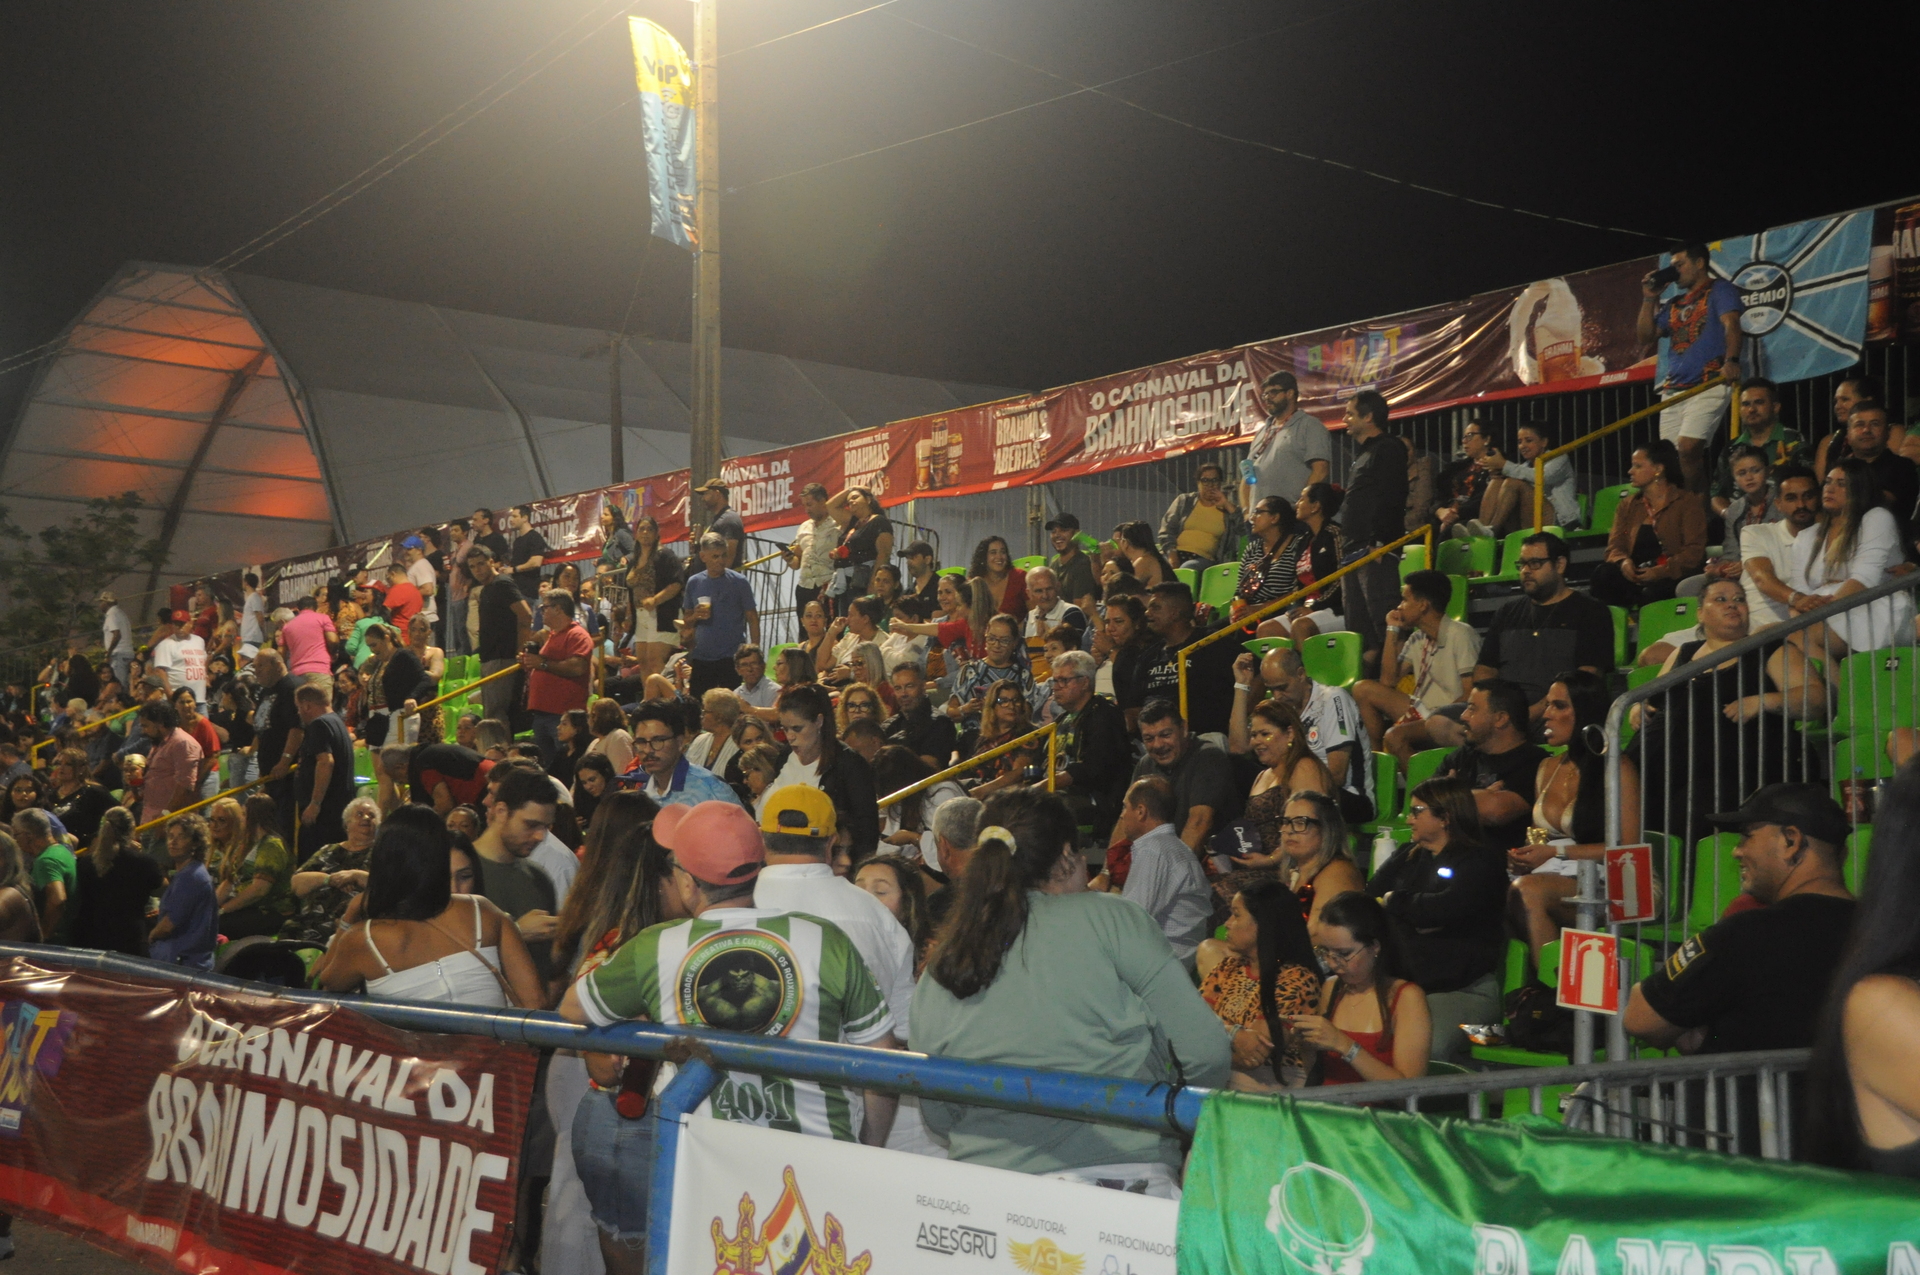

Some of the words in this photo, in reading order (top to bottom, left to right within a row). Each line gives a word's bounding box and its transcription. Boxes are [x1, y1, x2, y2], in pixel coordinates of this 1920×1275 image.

[1740, 287, 1786, 307] RÉMIO
[1090, 391, 1106, 411] O
[1108, 368, 1213, 407] CARNAVAL
[1217, 360, 1248, 384] DA
[995, 409, 1049, 447] BRAHMAS
[1084, 382, 1255, 454] BRAHMOSIDADE
[771, 459, 791, 476] DA
[844, 442, 890, 477] BRAHMAS
[993, 441, 1041, 476] ABERTAS
[689, 939, 733, 972] RECREATIVA
[735, 937, 741, 945] E
[742, 937, 780, 958] CULTURAL
[778, 956, 789, 967] OS
[684, 972, 695, 1016] SOCIEDADE
[764, 1022, 784, 1036] ICA
[198, 1016, 417, 1118] CARNAVAL
[427, 1067, 496, 1134] DA
[916, 1194, 970, 1216] REALIZAÇÃO:
[916, 1221, 997, 1260] ASESGRU
[1006, 1212, 1067, 1236] PRODUTORA:
